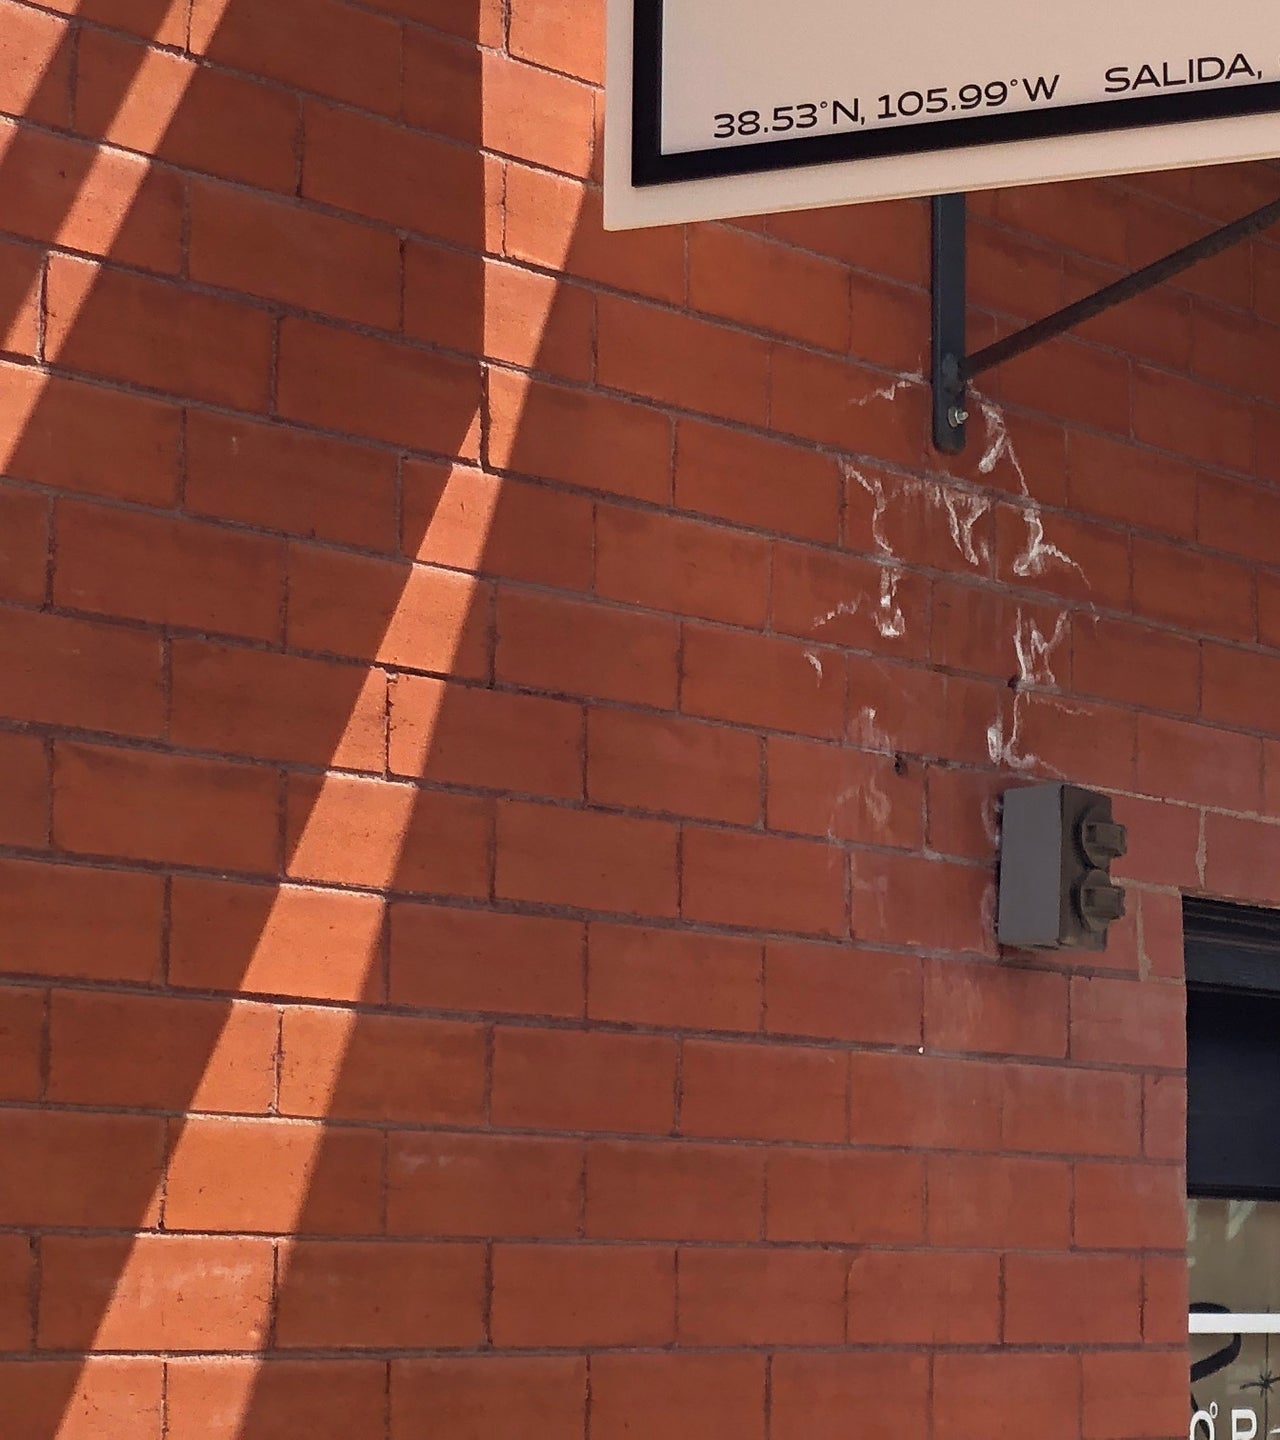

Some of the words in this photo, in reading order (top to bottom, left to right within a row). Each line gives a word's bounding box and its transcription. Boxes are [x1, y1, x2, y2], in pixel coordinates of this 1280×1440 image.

[713, 98, 866, 139] 38.53°N,
[877, 74, 1061, 120] 105.99°W
[1104, 53, 1263, 93] SALIDA,
